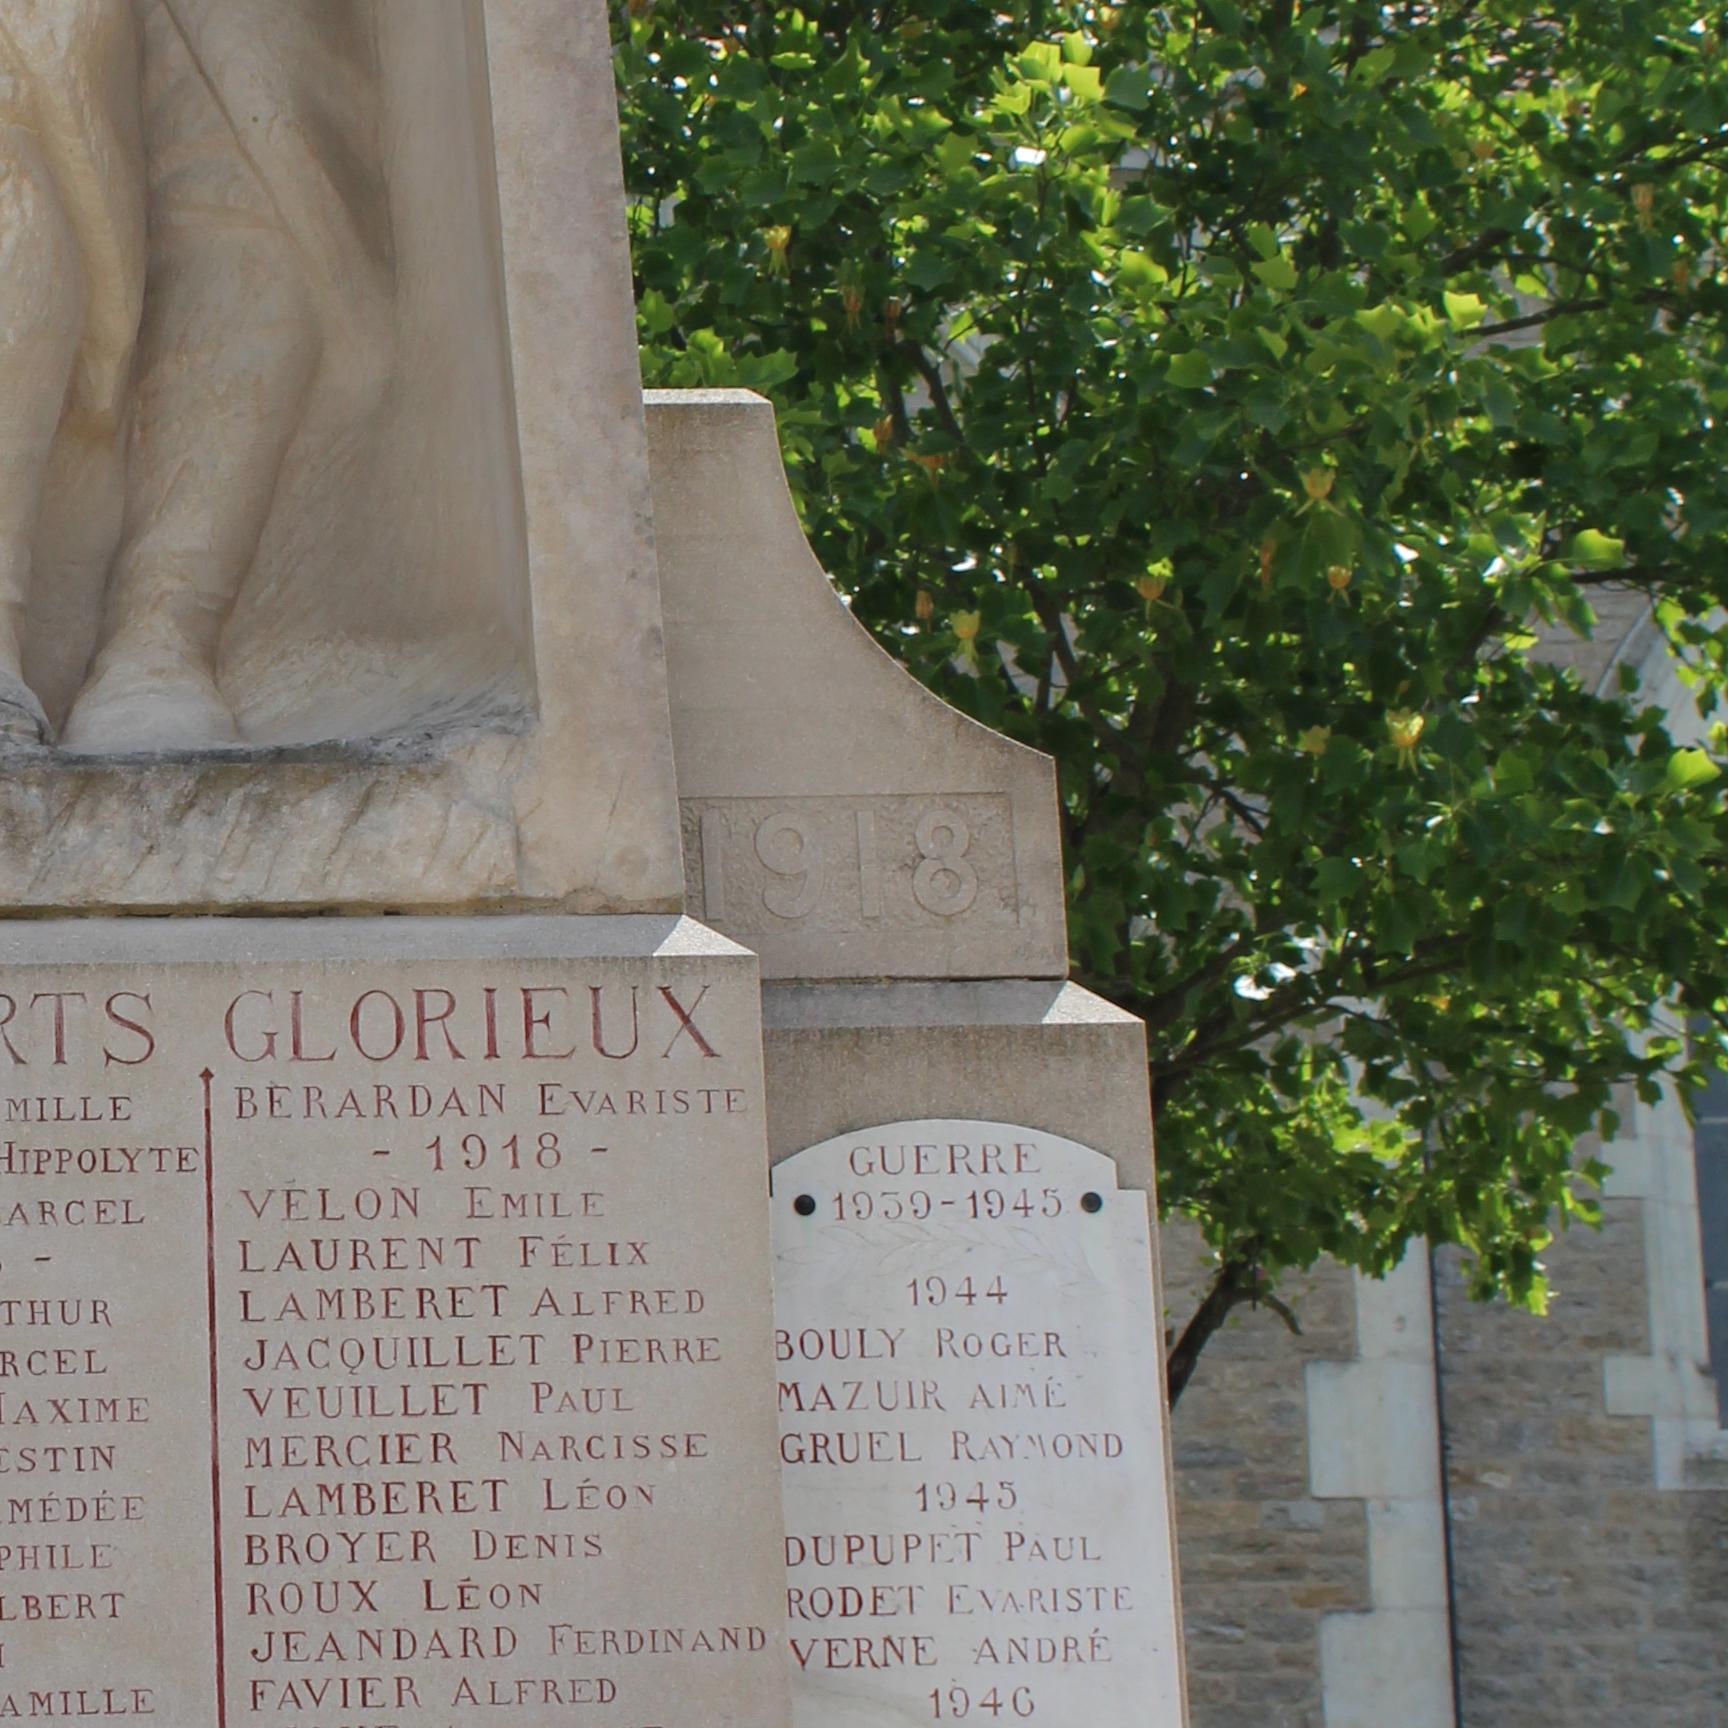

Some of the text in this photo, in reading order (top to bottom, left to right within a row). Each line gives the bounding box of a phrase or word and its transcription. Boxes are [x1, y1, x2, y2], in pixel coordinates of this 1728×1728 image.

[700, 808, 978, 920] 1918
[225, 986, 720, 1062] GLORIEUX
[849, 1144, 1041, 1176] GUERRE
[239, 1237, 481, 1272] LAURENT
[239, 1285, 508, 1322] LAMBERET
[908, 1276, 1008, 1306] 1944
[244, 1334, 543, 1375] JACQUILLET
[776, 1328, 906, 1361] BOULY
[243, 1383, 488, 1418] VEUILLET
[778, 1381, 945, 1412] MAZUIR
[245, 1433, 457, 1468] MERCIER
[780, 1432, 922, 1465] GRUEL
[245, 1479, 507, 1517] LAMBERET
[916, 1481, 1016, 1513] 1945
[246, 1530, 436, 1565] BROYER
[247, 1580, 378, 1615] ROUX
[787, 1586, 925, 1620] RODET
[251, 1627, 517, 1663] JEANDARD
[790, 1635, 938, 1670] VERNE
[251, 1676, 420, 1711] FAVIER
[930, 1687, 1035, 1719] 1946
